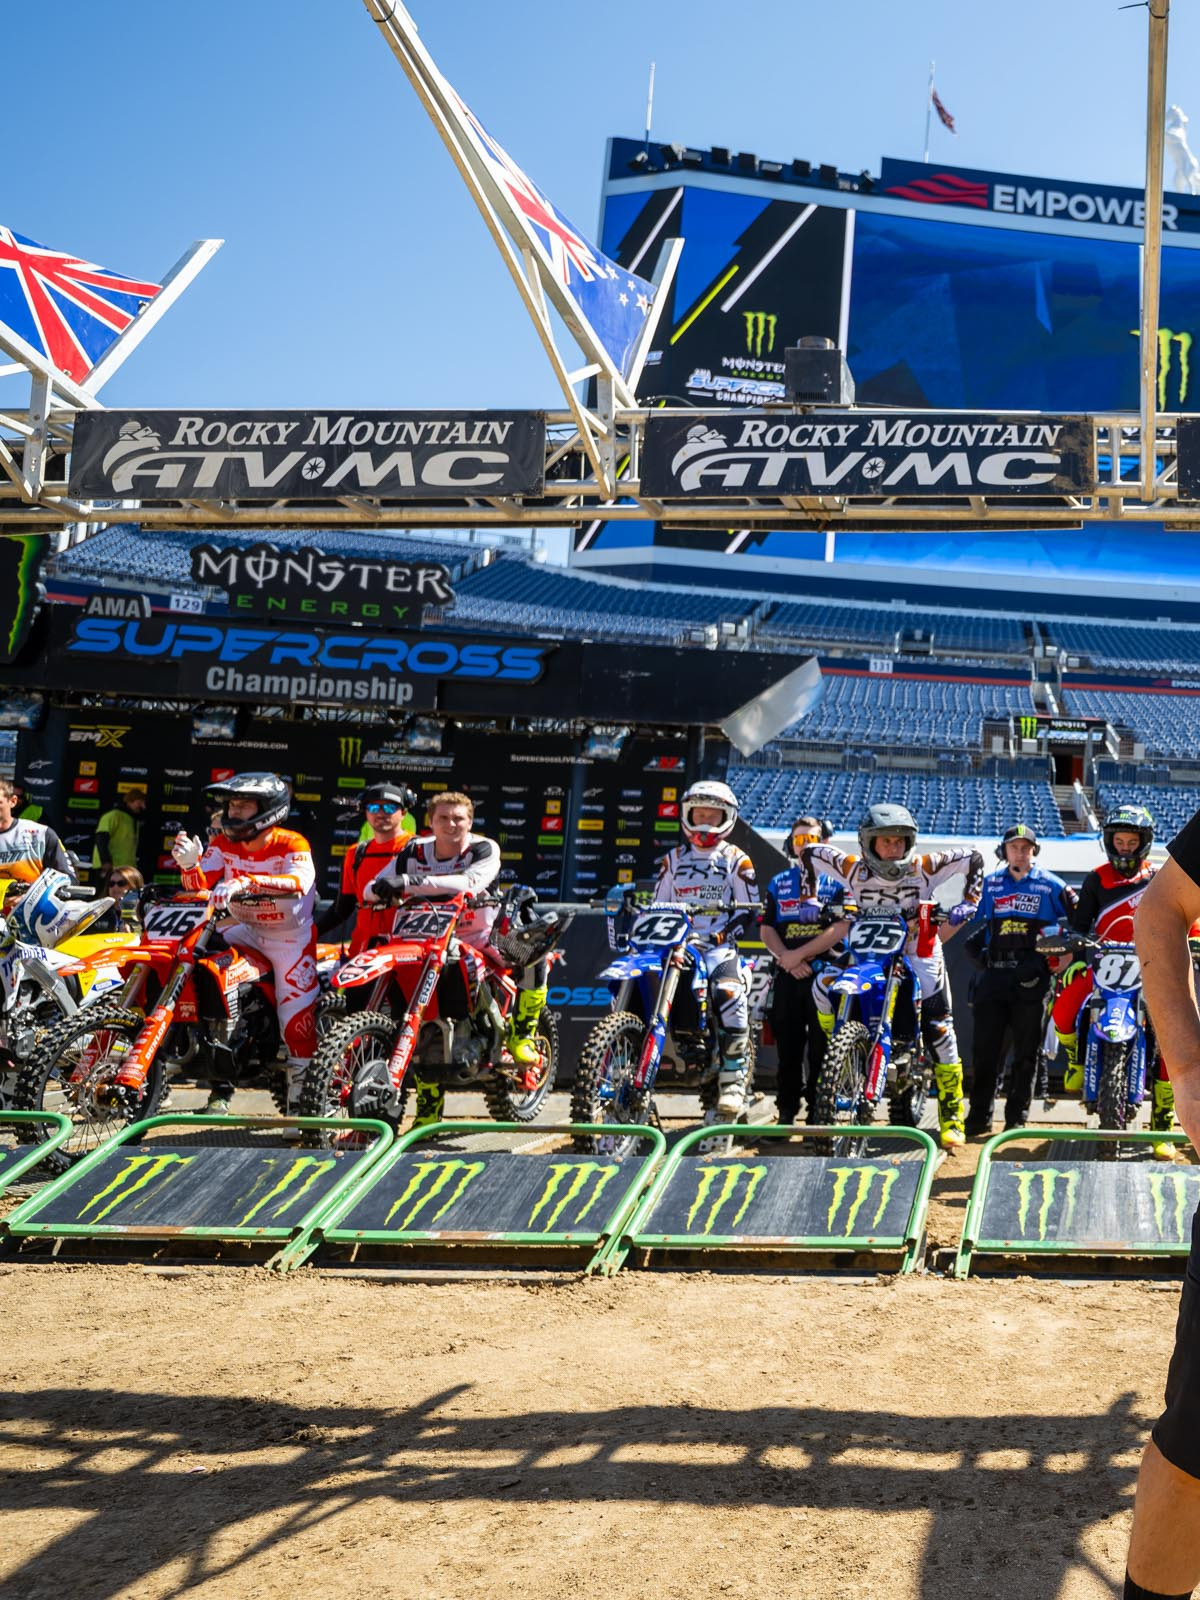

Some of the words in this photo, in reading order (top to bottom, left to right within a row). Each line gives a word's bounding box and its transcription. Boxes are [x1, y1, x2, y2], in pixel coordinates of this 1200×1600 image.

[993, 184, 1178, 230] EMPOWER
[169, 416, 300, 446] ROCKY
[302, 416, 514, 446] MOUNTAIN
[734, 419, 859, 448] ROCKY
[861, 418, 1064, 448] MOUNTAIN
[198, 549, 448, 599] MONSTER
[88, 596, 141, 618] AMA
[173, 598, 201, 612] 129
[236, 594, 410, 618] ENERGY
[68, 618, 545, 680] SUPERCROSS
[206, 666, 413, 706] Championship
[146, 911, 203, 937] 146
[634, 916, 683, 941] 43
[851, 923, 902, 950] 35
[1096, 954, 1142, 987] 87
[420, 970, 436, 1005] ENZO
[145, 1021, 168, 1060] DUNLOP
